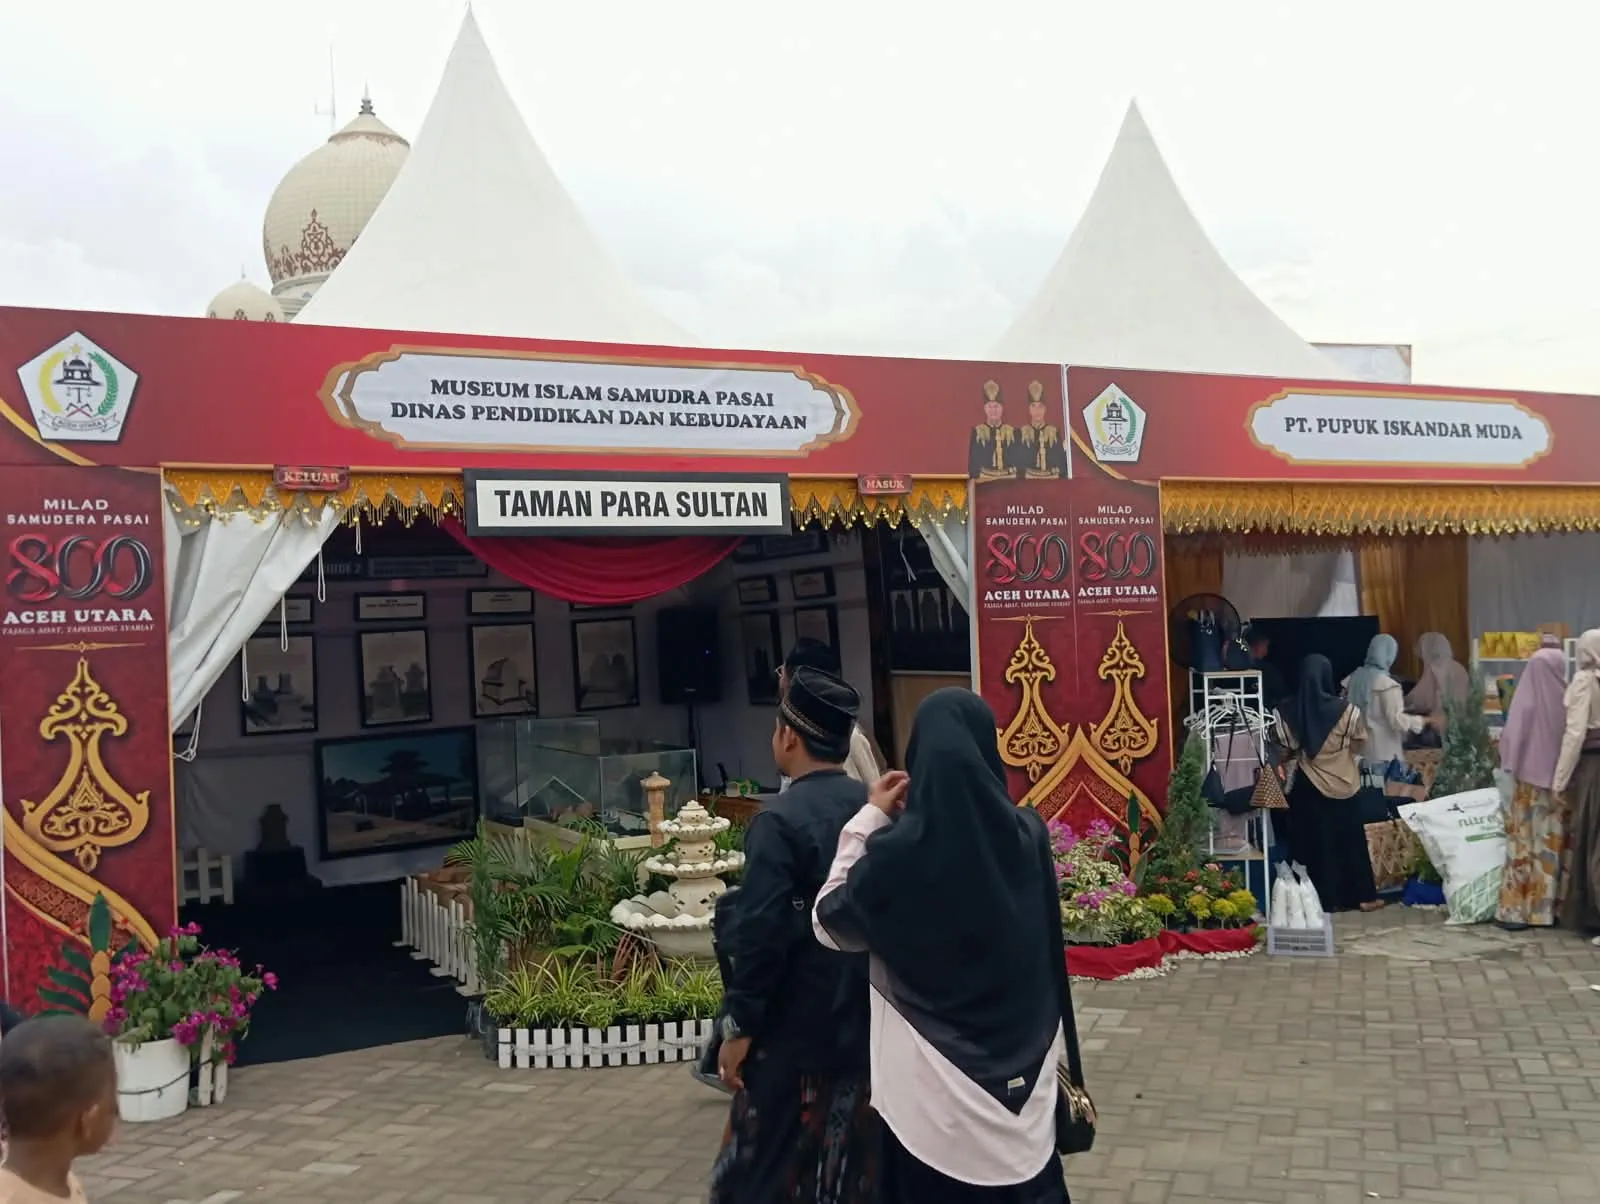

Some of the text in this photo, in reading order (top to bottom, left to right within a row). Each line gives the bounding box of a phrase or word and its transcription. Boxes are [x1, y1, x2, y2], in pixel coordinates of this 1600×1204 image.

[430, 379, 775, 408] MUSEUM ISLAM SAMUDRA PASAI
[391, 402, 808, 430] DINAS PENDIDIKAN DAN KEBUDAYAAN
[1285, 416, 1523, 440] PT. PUPUK ISKANDAR MUDA
[284, 471, 340, 483] KELUAR
[866, 479, 905, 489] MASUK
[43, 499, 109, 511] MILAD
[493, 489, 769, 518] TAMAN PARA SULTAN
[1098, 505, 1132, 514] MILAD
[1007, 505, 1044, 515] MILAD
[7, 514, 150, 525] SAMUDERA PASAI
[986, 517, 1067, 526] SAMUDERA PASAI
[1078, 516, 1154, 525] SAMUDERA PASAI
[985, 532, 1068, 583] 800
[1078, 531, 1157, 581] 800
[6, 533, 153, 602] 800
[984, 589, 1070, 601] ACEH UTARA
[1078, 585, 1158, 597] ACEH UTARA
[3, 608, 153, 624] ACEH UTARA
